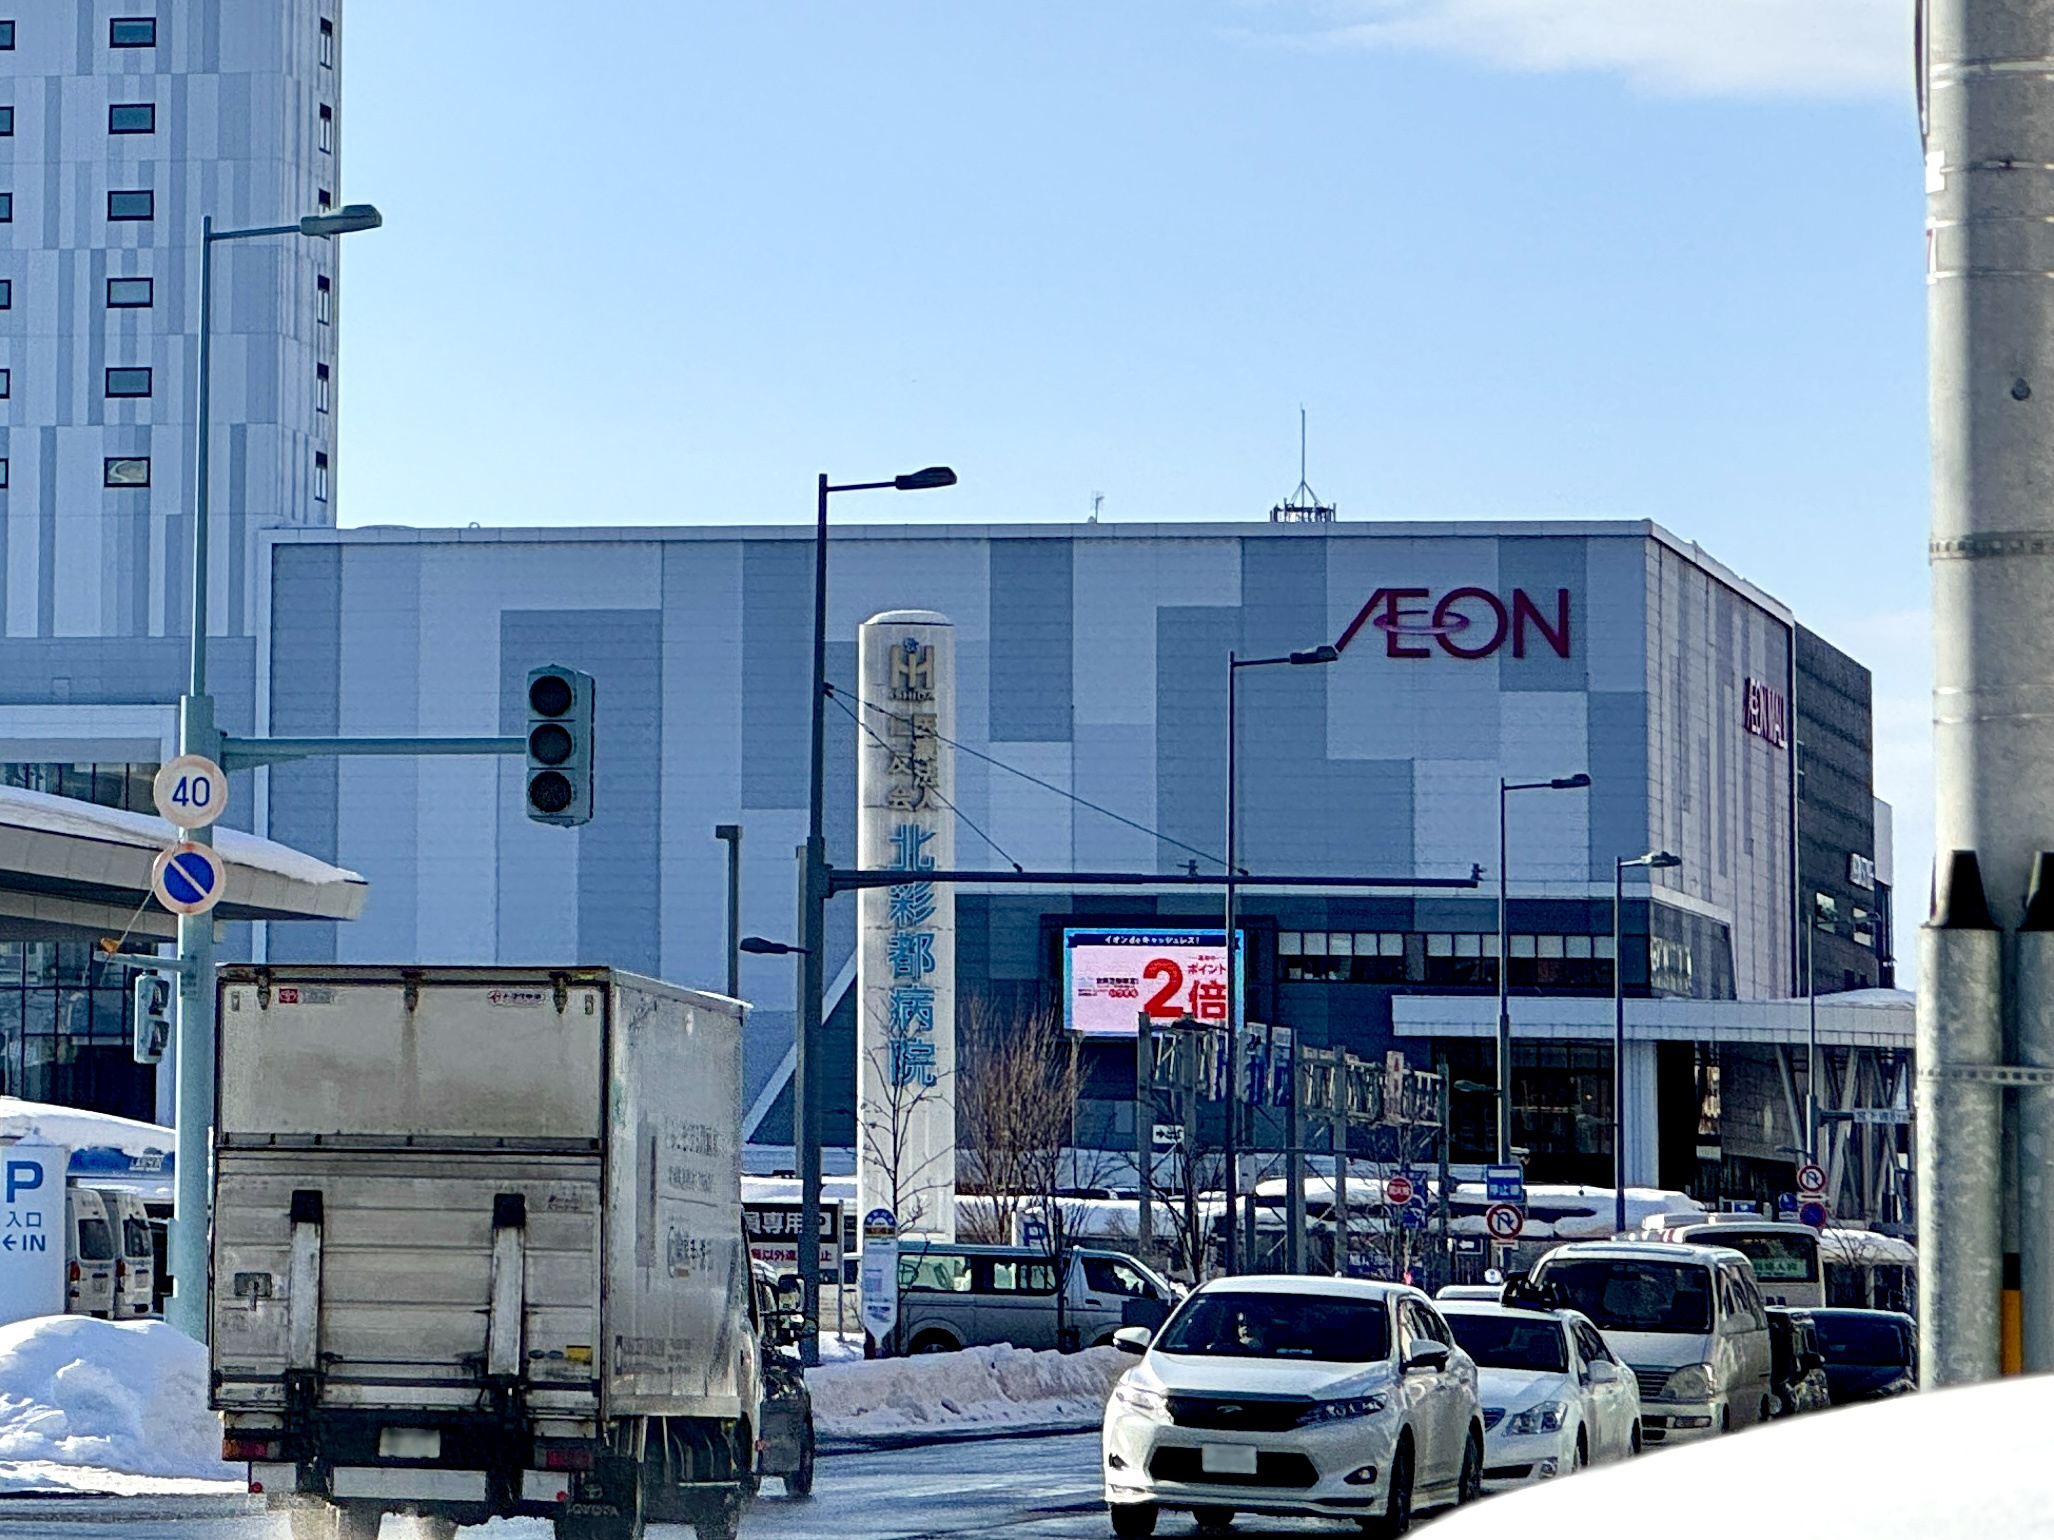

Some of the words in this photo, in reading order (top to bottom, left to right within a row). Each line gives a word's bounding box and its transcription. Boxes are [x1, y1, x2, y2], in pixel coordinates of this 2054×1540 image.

[172, 776, 211, 807] 40
[887, 823, 937, 1087] 北彩都病院
[1187, 961, 1227, 975] ポイント
[6, 1160, 44, 1203] P
[6, 1211, 42, 1228] 入口
[23, 1234, 46, 1252] IN
